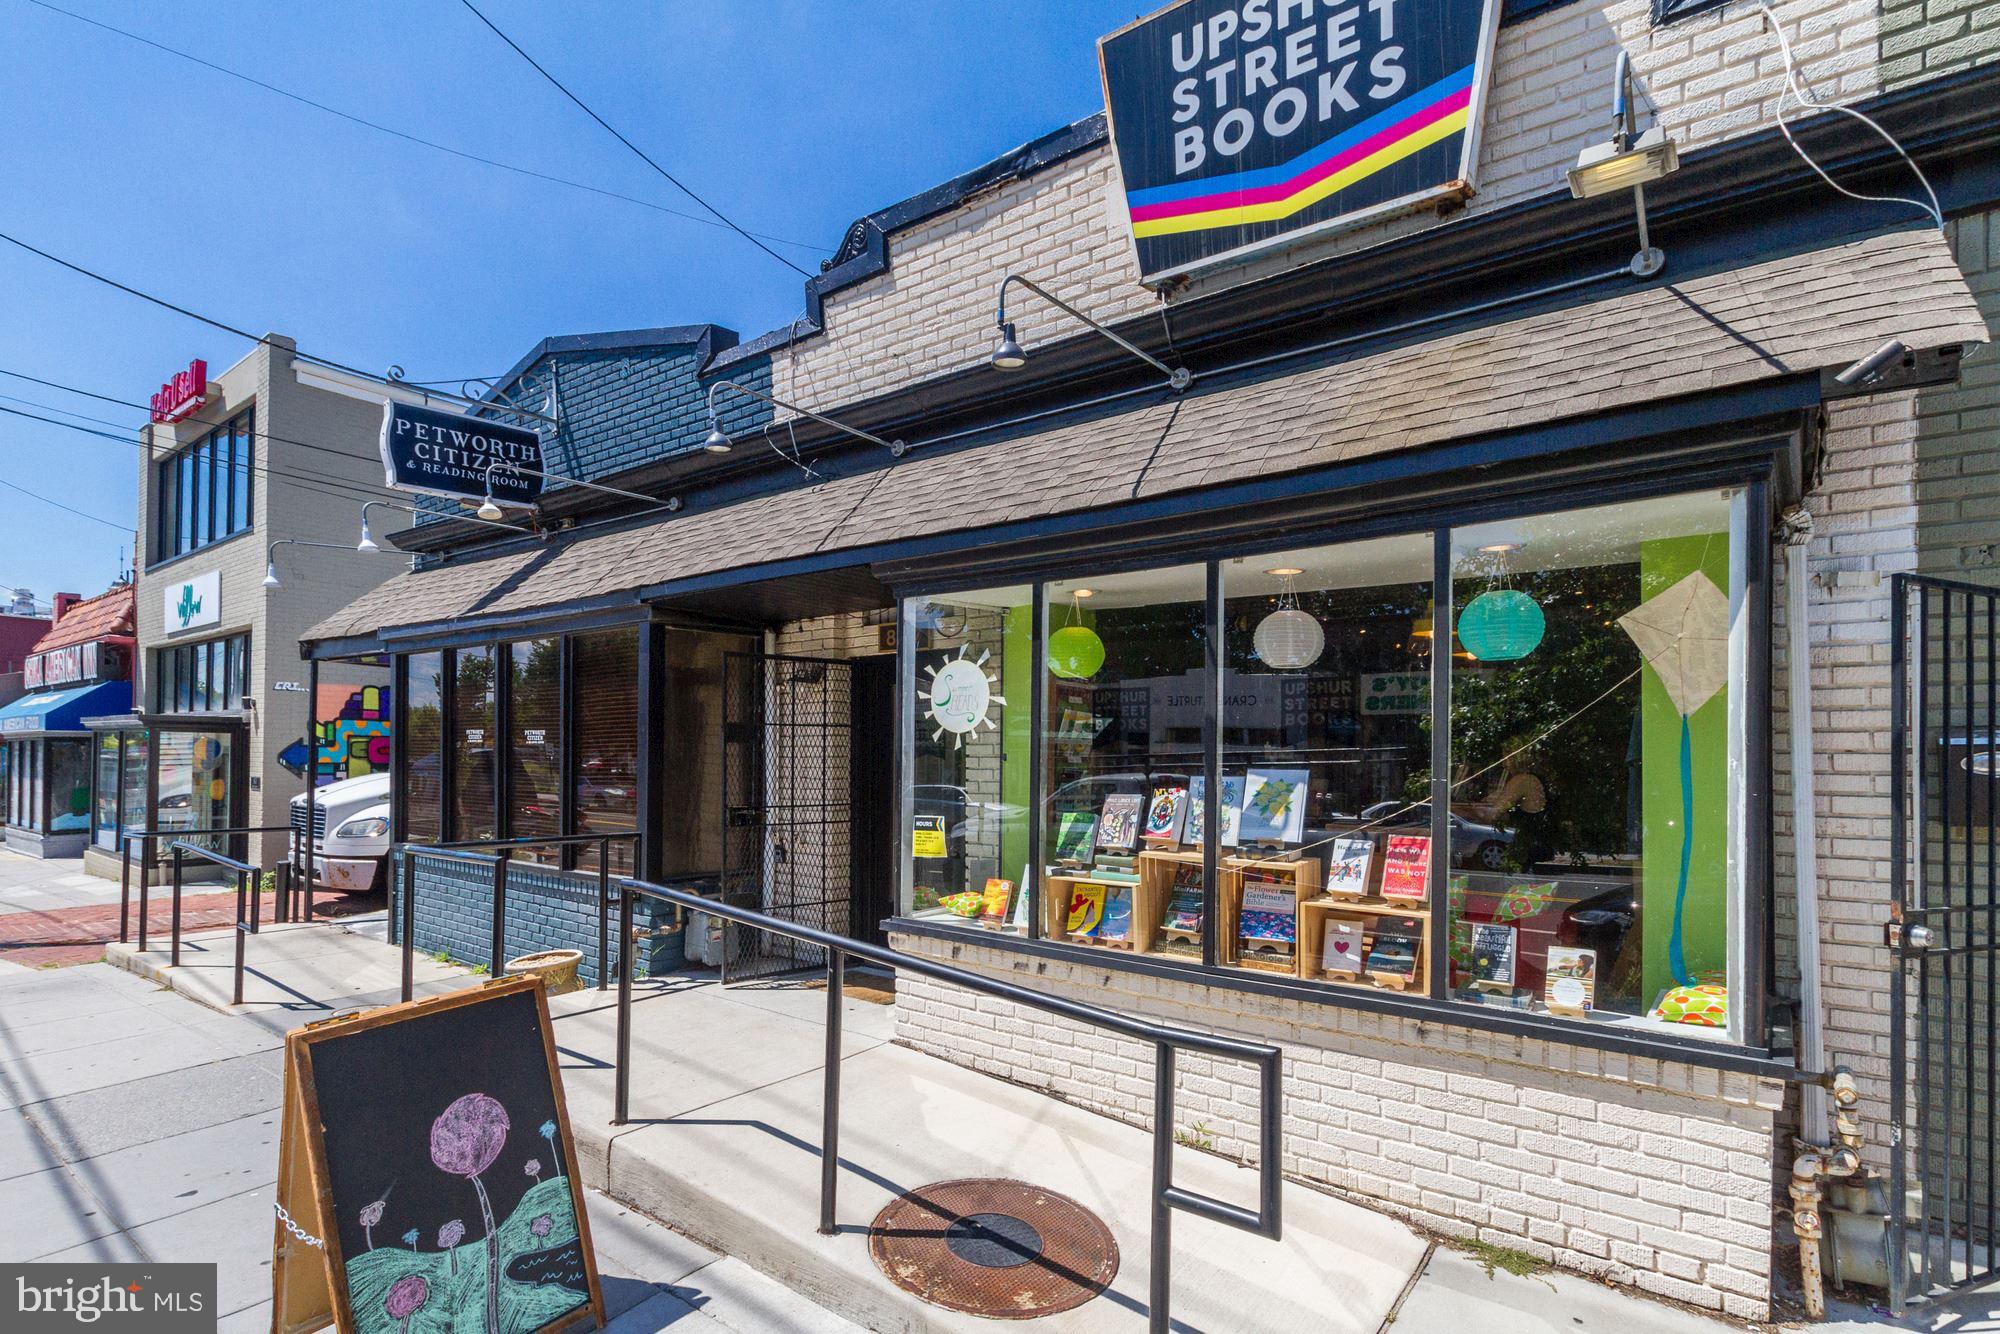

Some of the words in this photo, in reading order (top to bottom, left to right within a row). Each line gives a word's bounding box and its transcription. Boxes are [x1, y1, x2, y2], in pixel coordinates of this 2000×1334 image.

[1171, 0, 1349, 73] UPSH
[1172, 0, 1399, 123] STREET
[1174, 46, 1407, 176] BOOKS
[395, 417, 536, 462] PETWORTH
[406, 460, 416, 469] &
[422, 459, 485, 481] READING
[491, 475, 529, 490] ROOM
[414, 442, 521, 477] CITIZEN
[1387, 867, 1405, 875] WAS
[1408, 869, 1426, 877] NOT
[1245, 898, 1265, 906] Bible
[1246, 891, 1286, 901] Gardener's
[1254, 885, 1278, 894] Flower
